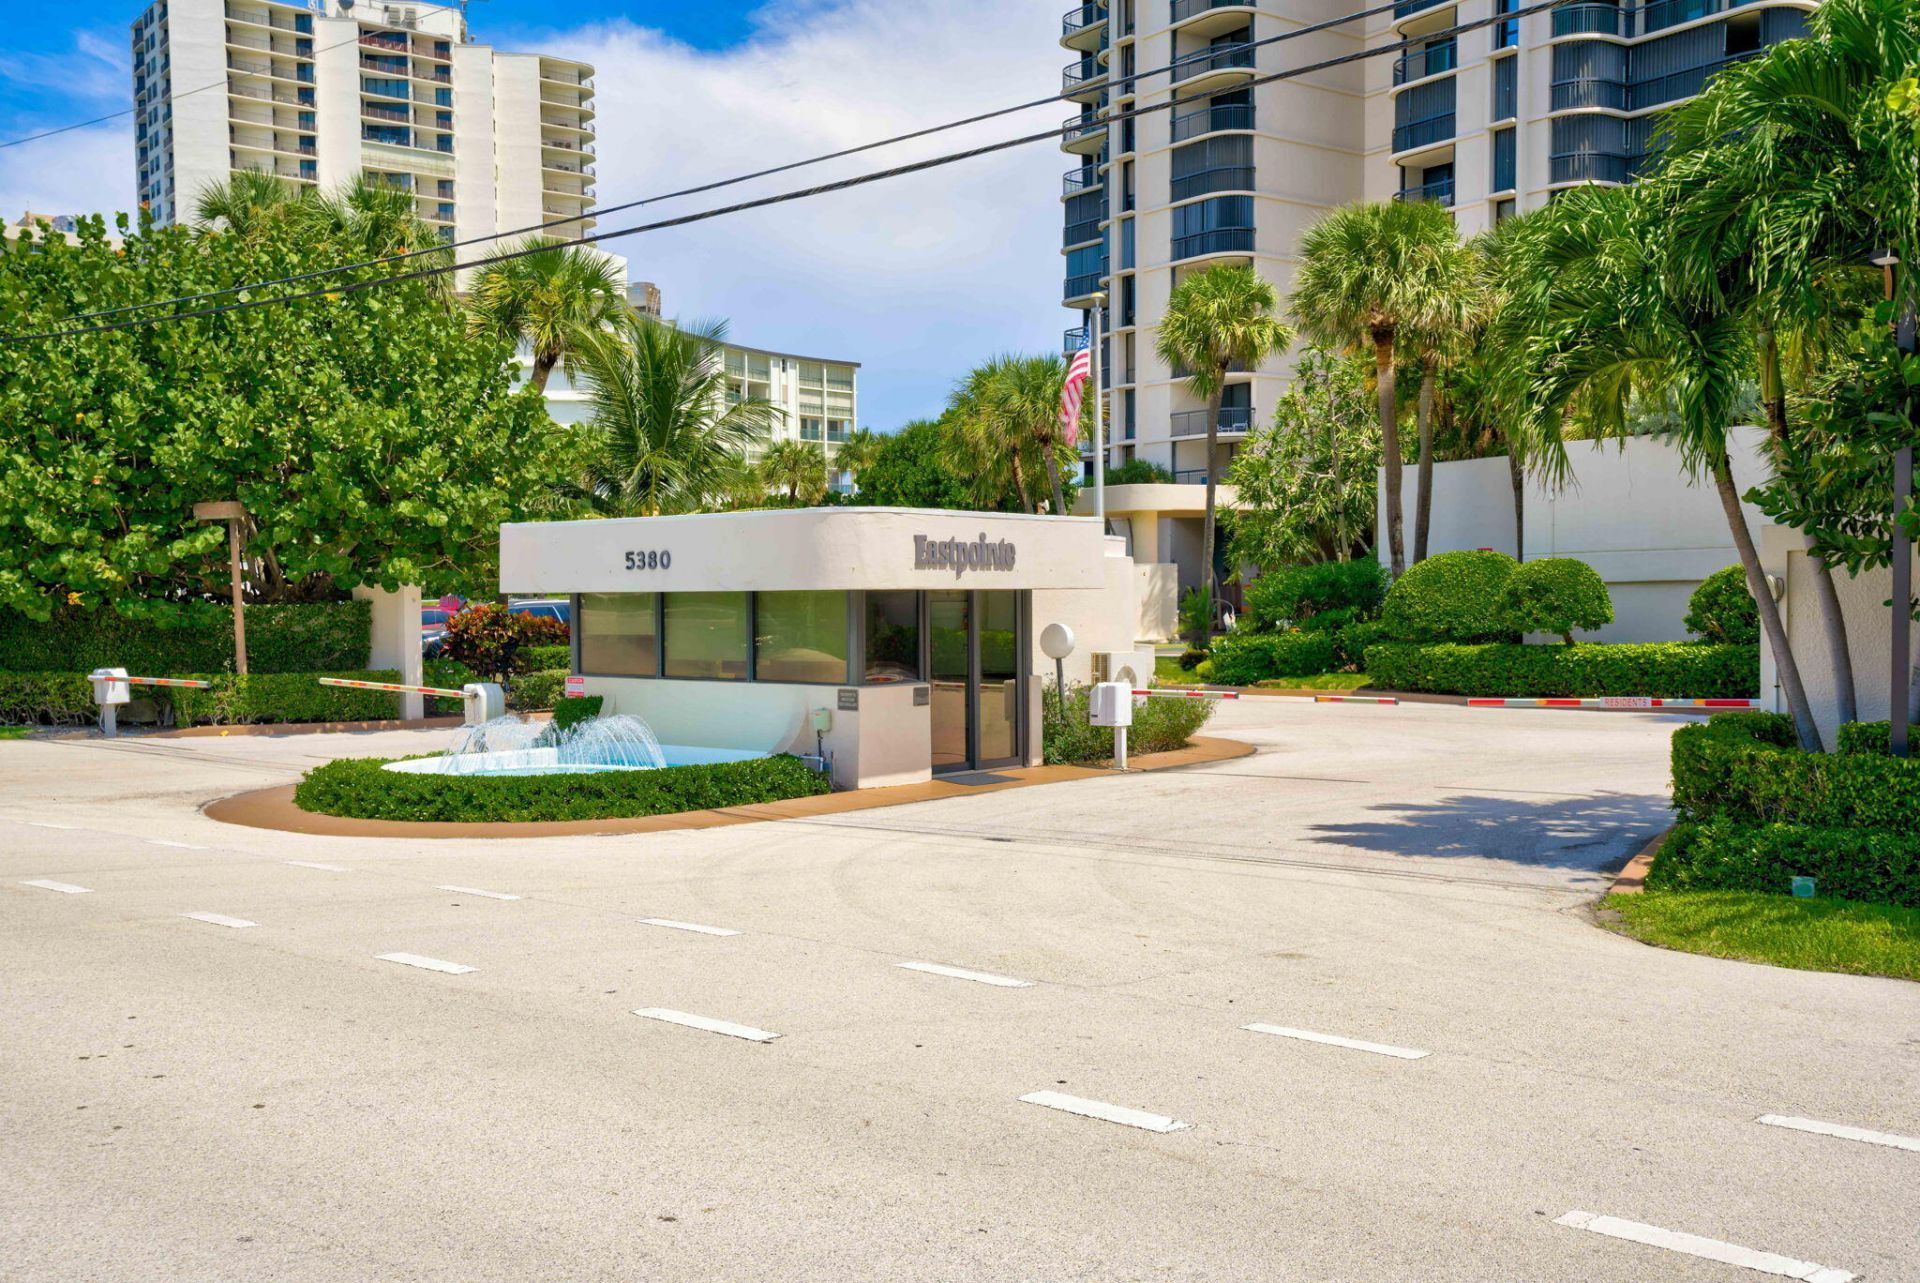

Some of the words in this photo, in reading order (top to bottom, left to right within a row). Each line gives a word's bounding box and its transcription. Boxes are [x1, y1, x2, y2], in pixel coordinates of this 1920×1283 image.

[625, 550, 671, 570] 5380
[913, 532, 1016, 580] Eastpointe
[1605, 697, 1647, 707] RESIDENTS
